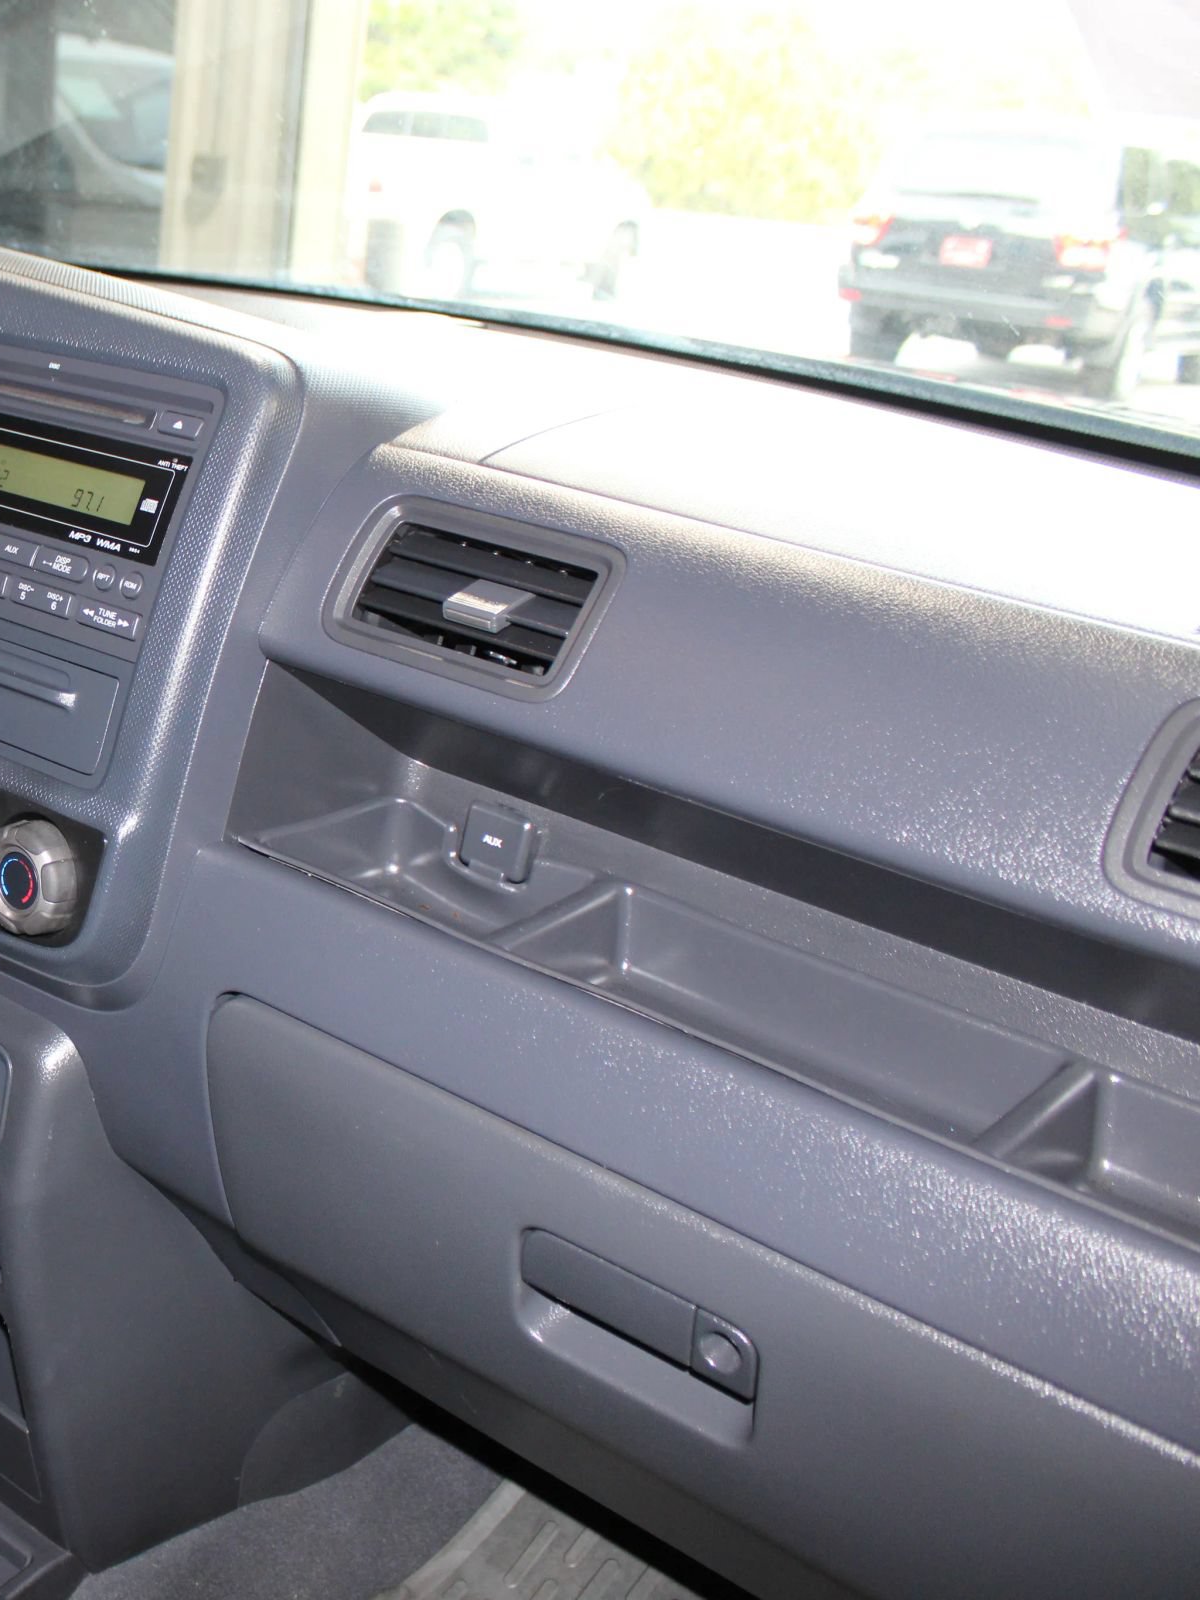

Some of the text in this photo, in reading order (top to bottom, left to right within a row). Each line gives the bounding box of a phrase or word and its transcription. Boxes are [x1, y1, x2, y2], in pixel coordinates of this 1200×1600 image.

[157, 460, 188, 472] ANTI THEFT
[68, 530, 92, 543] MP3
[95, 537, 122, 552] WMA
[4, 544, 19, 555] AUX
[54, 554, 71, 564] DISP
[51, 561, 72, 574] MODE
[97, 572, 110, 582] RPT
[123, 580, 138, 590] RDM
[19, 591, 26, 601] 5
[50, 601, 57, 611] 6
[98, 607, 117, 620] TUNE
[93, 615, 117, 628] FOLDER
[482, 834, 503, 849] AUX
